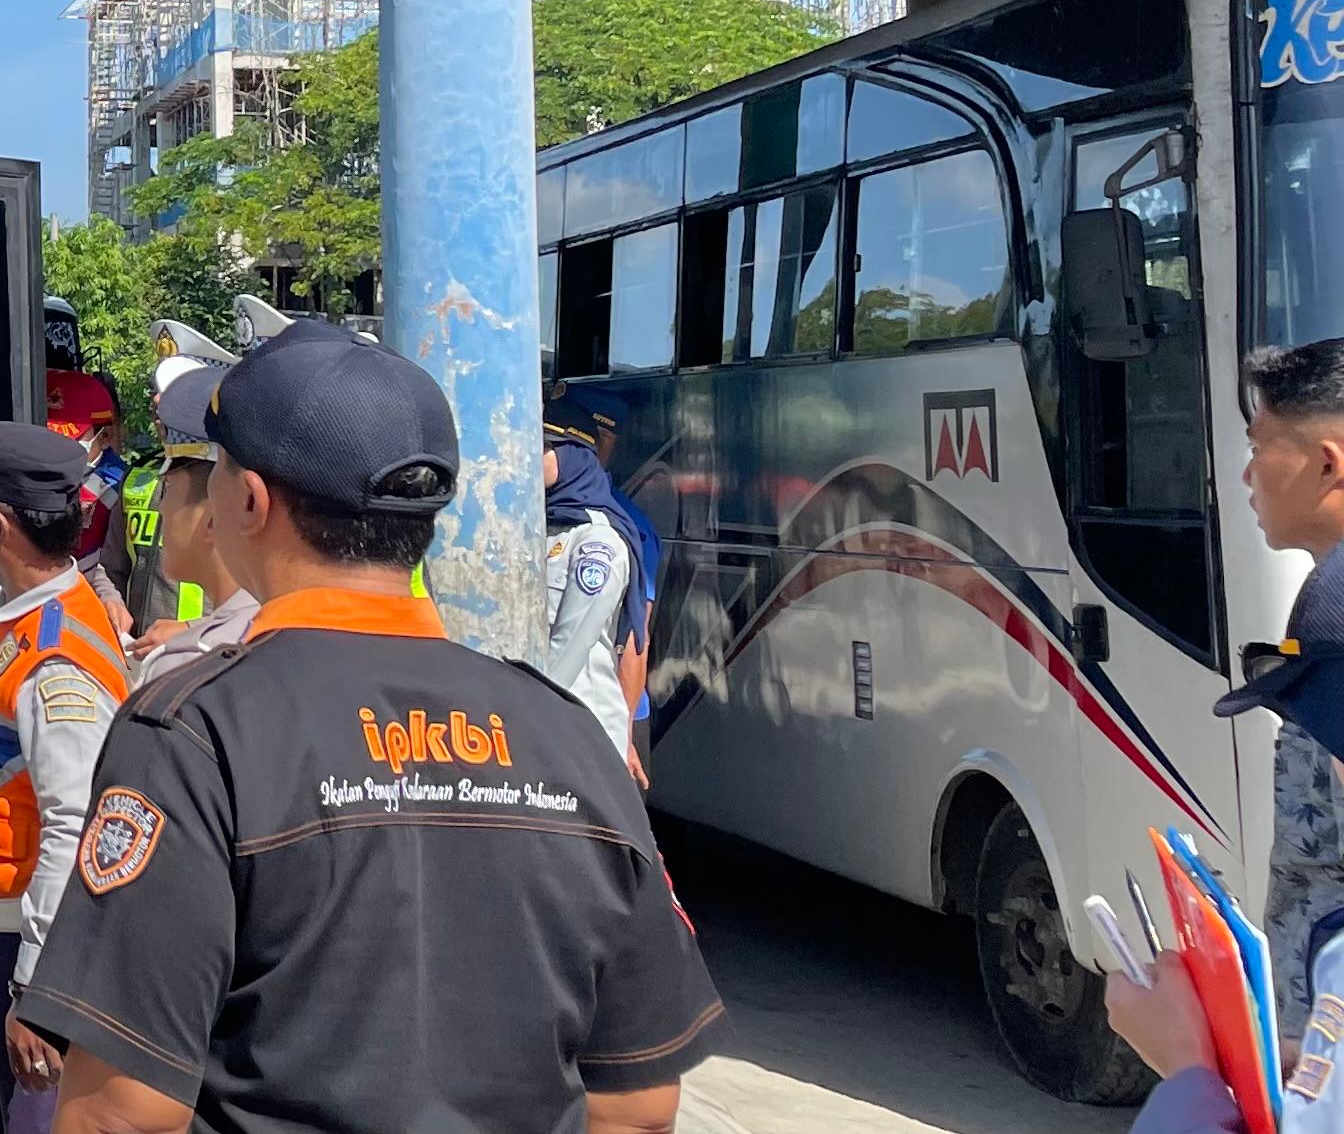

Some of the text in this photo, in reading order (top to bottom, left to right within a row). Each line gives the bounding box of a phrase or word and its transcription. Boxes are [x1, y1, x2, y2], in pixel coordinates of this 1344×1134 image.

[358, 706, 513, 774] ipkbi
[459, 778, 521, 804] Bermotor
[524, 781, 578, 812] Indonesia
